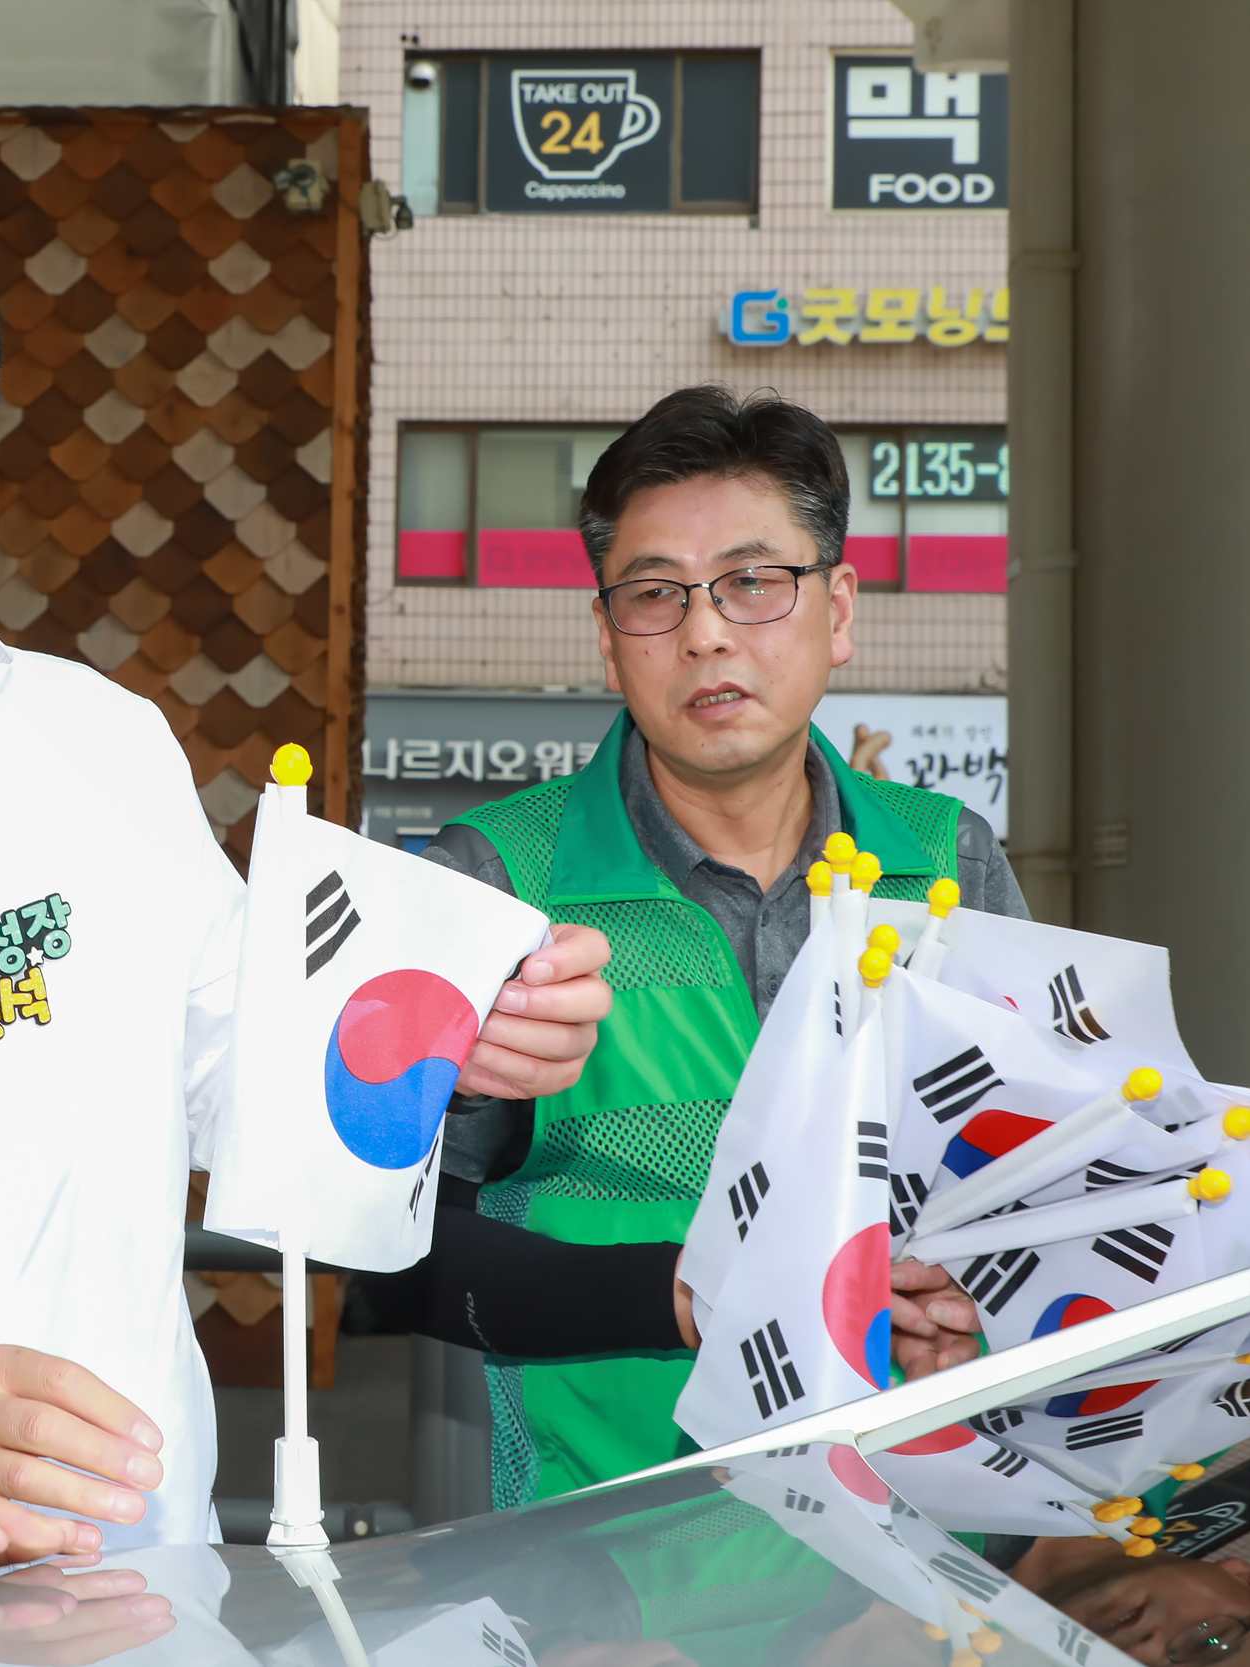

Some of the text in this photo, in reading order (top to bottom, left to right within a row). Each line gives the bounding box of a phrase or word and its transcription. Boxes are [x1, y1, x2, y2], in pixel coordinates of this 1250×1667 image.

[521, 83, 627, 104] TAKE OUT
[847, 66, 979, 164] 맥
[540, 110, 604, 154] 24
[524, 180, 626, 201] Cappuccino
[869, 173, 995, 204] FOOD
